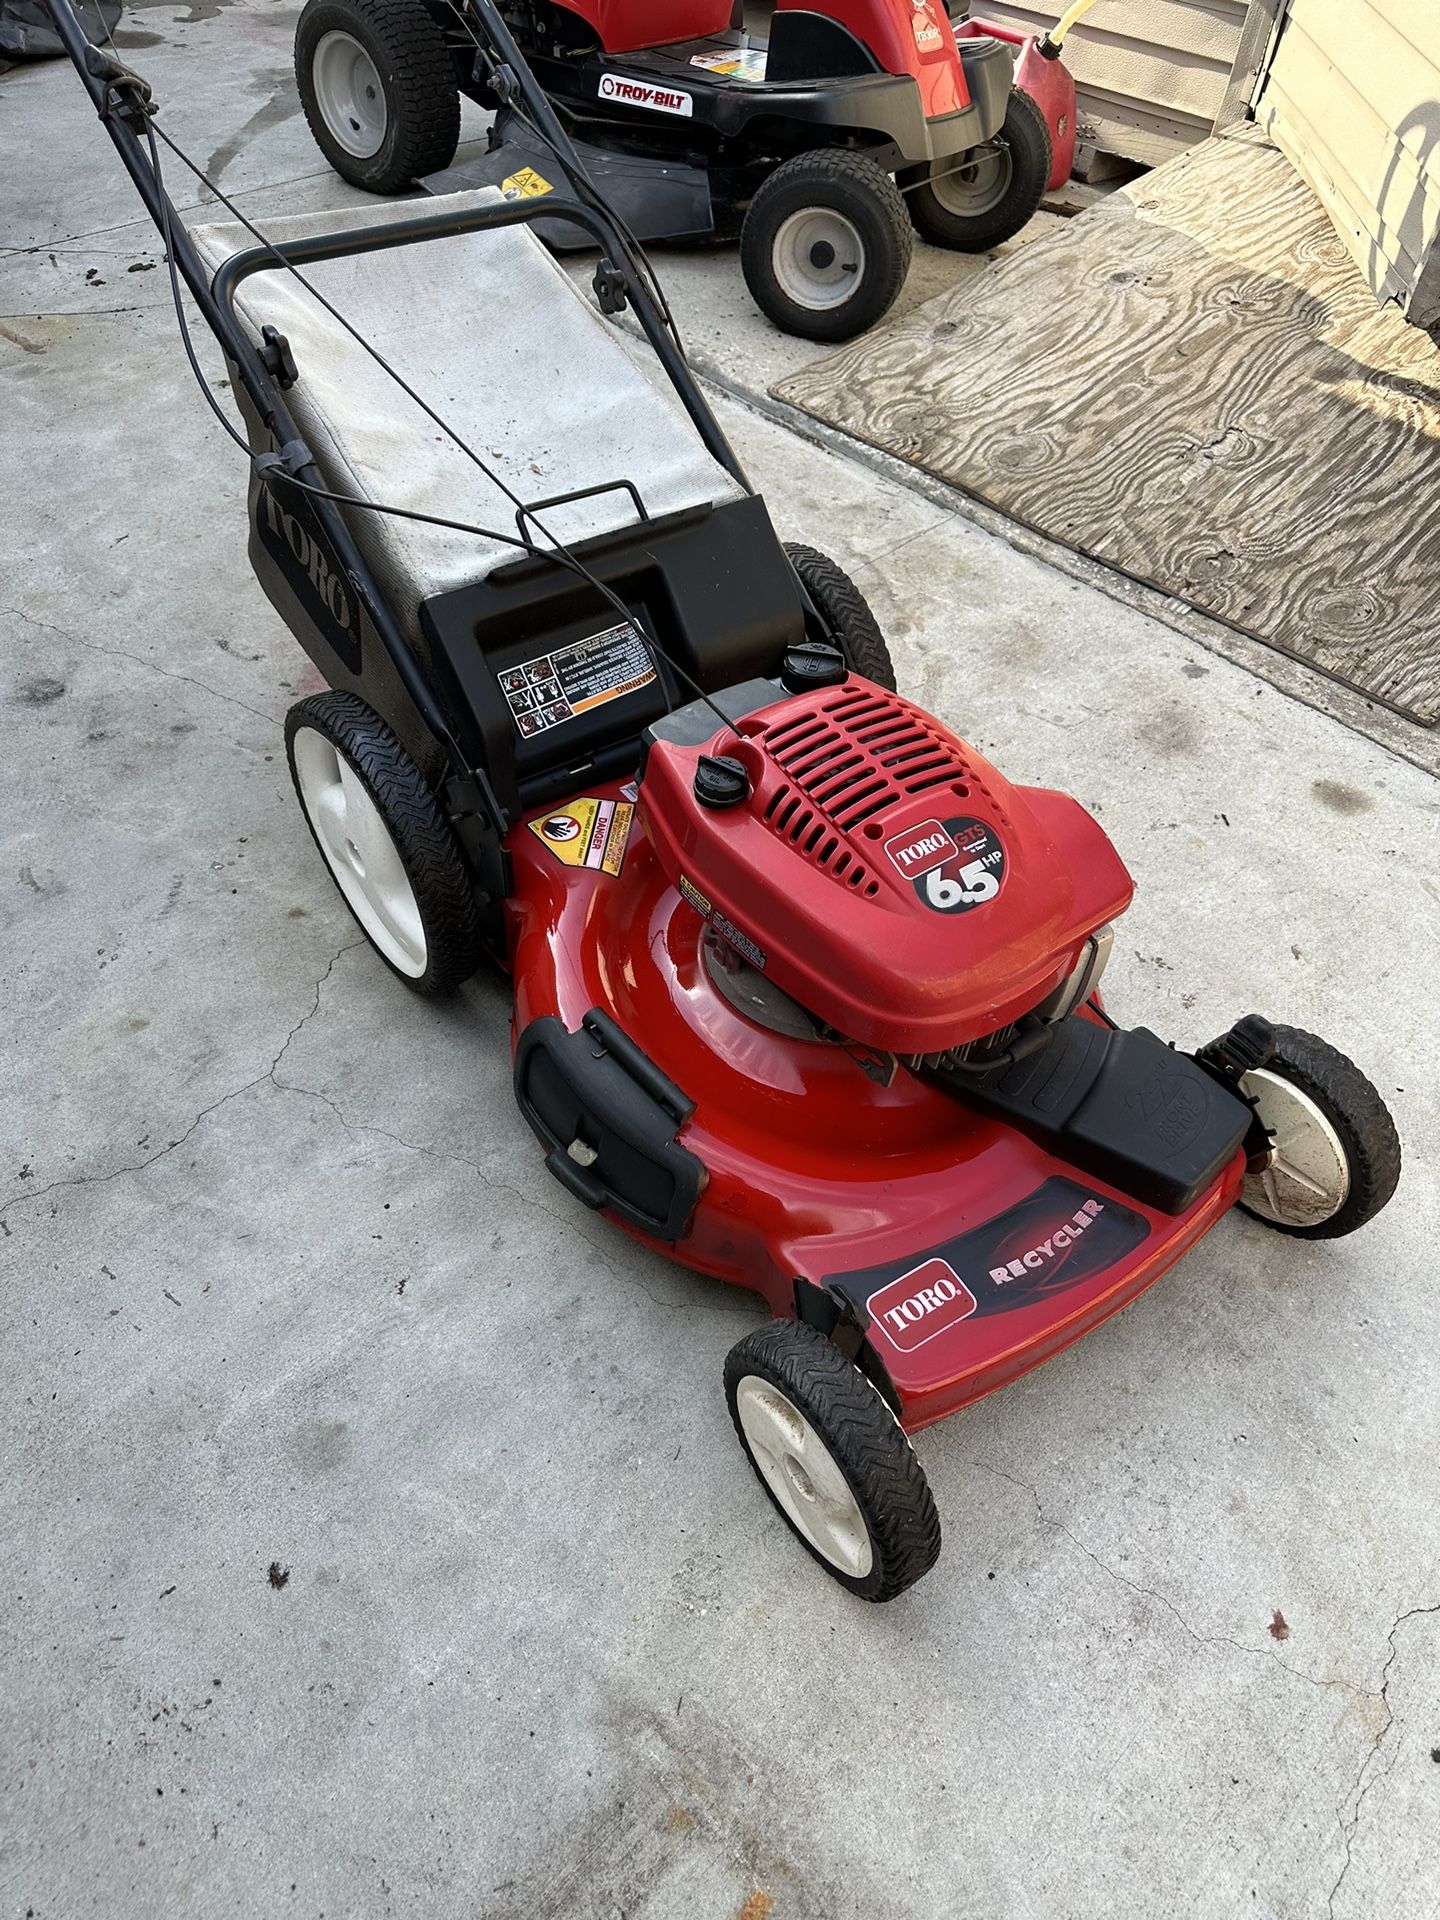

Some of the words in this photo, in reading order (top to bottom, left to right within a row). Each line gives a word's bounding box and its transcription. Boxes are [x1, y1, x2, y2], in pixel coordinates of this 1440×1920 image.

[615, 82, 685, 109] TROY-BILT
[261, 482, 351, 629] TORO
[615, 671, 654, 694] WARNING
[591, 816, 607, 850] DANGER
[895, 832, 947, 867] TORO
[953, 823, 986, 846] GTS
[926, 859, 1000, 909] 6.5
[981, 850, 1003, 868] HP
[988, 1198, 1105, 1287] RECYCLER
[882, 1278, 959, 1333] TORO
